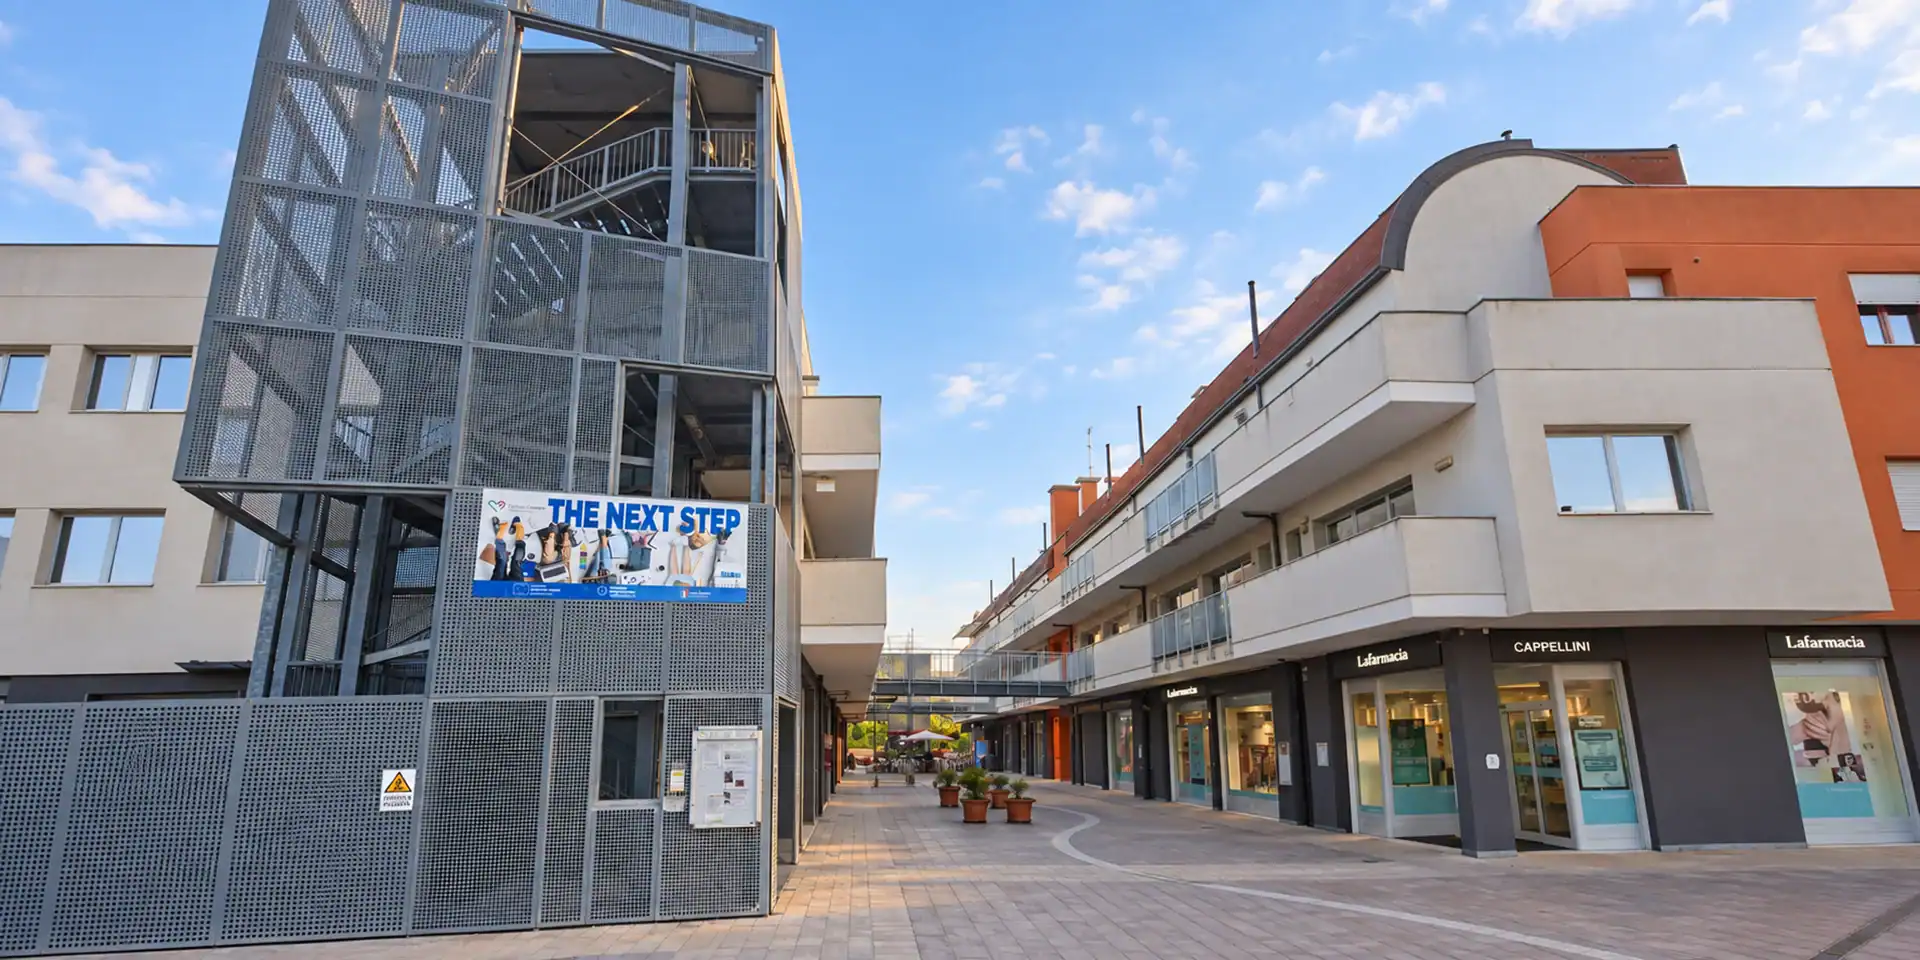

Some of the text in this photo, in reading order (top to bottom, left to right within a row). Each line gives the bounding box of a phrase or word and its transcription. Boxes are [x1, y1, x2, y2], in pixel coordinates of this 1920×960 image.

[548, 498, 741, 535] THE NEXT STEP
[1513, 641, 1591, 653] CAPPELLINI
[1786, 635, 1866, 649] Lafarmacia
[1357, 648, 1409, 668] Lafarmacia
